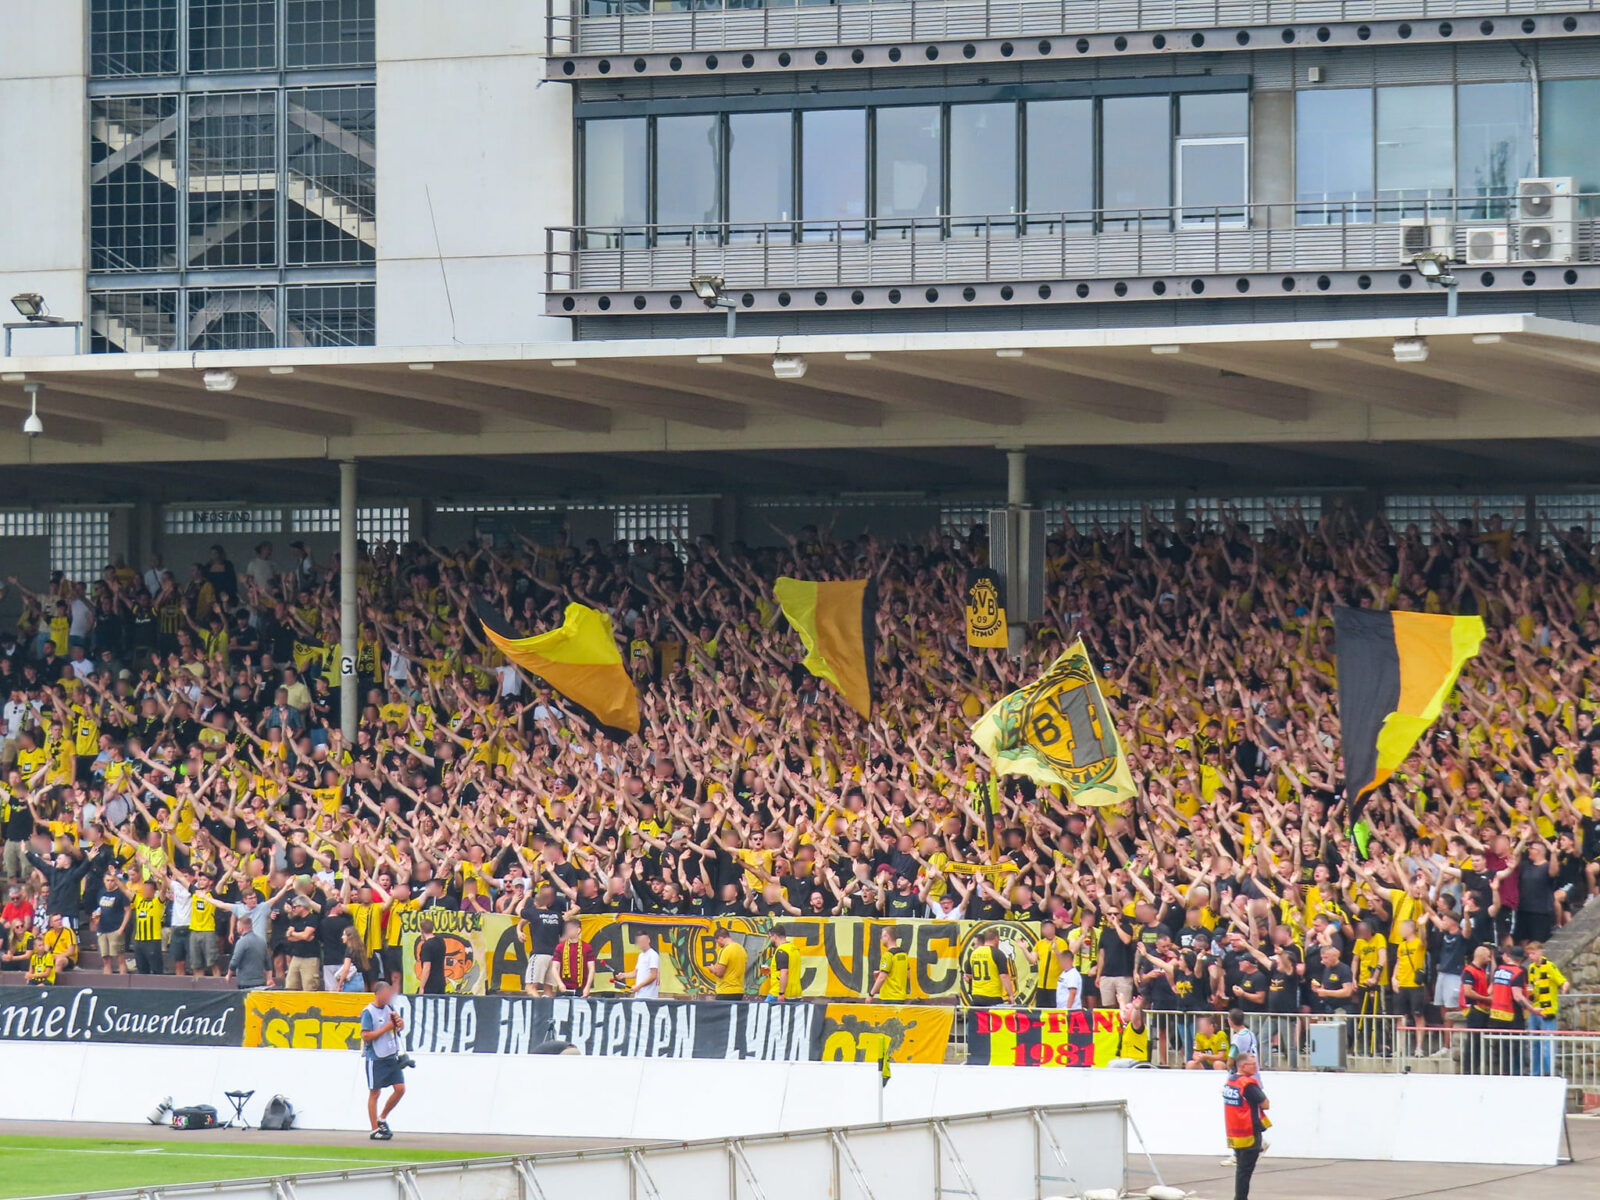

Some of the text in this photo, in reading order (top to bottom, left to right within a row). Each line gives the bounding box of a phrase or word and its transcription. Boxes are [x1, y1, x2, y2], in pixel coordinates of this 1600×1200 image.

[976, 615, 988, 623] 09
[341, 656, 353, 674] G
[972, 961, 991, 980] 01
[0, 988, 235, 1038] niel! Sauerland
[725, 1002, 815, 1061] LYNN
[1011, 1043, 1096, 1067] 1981
